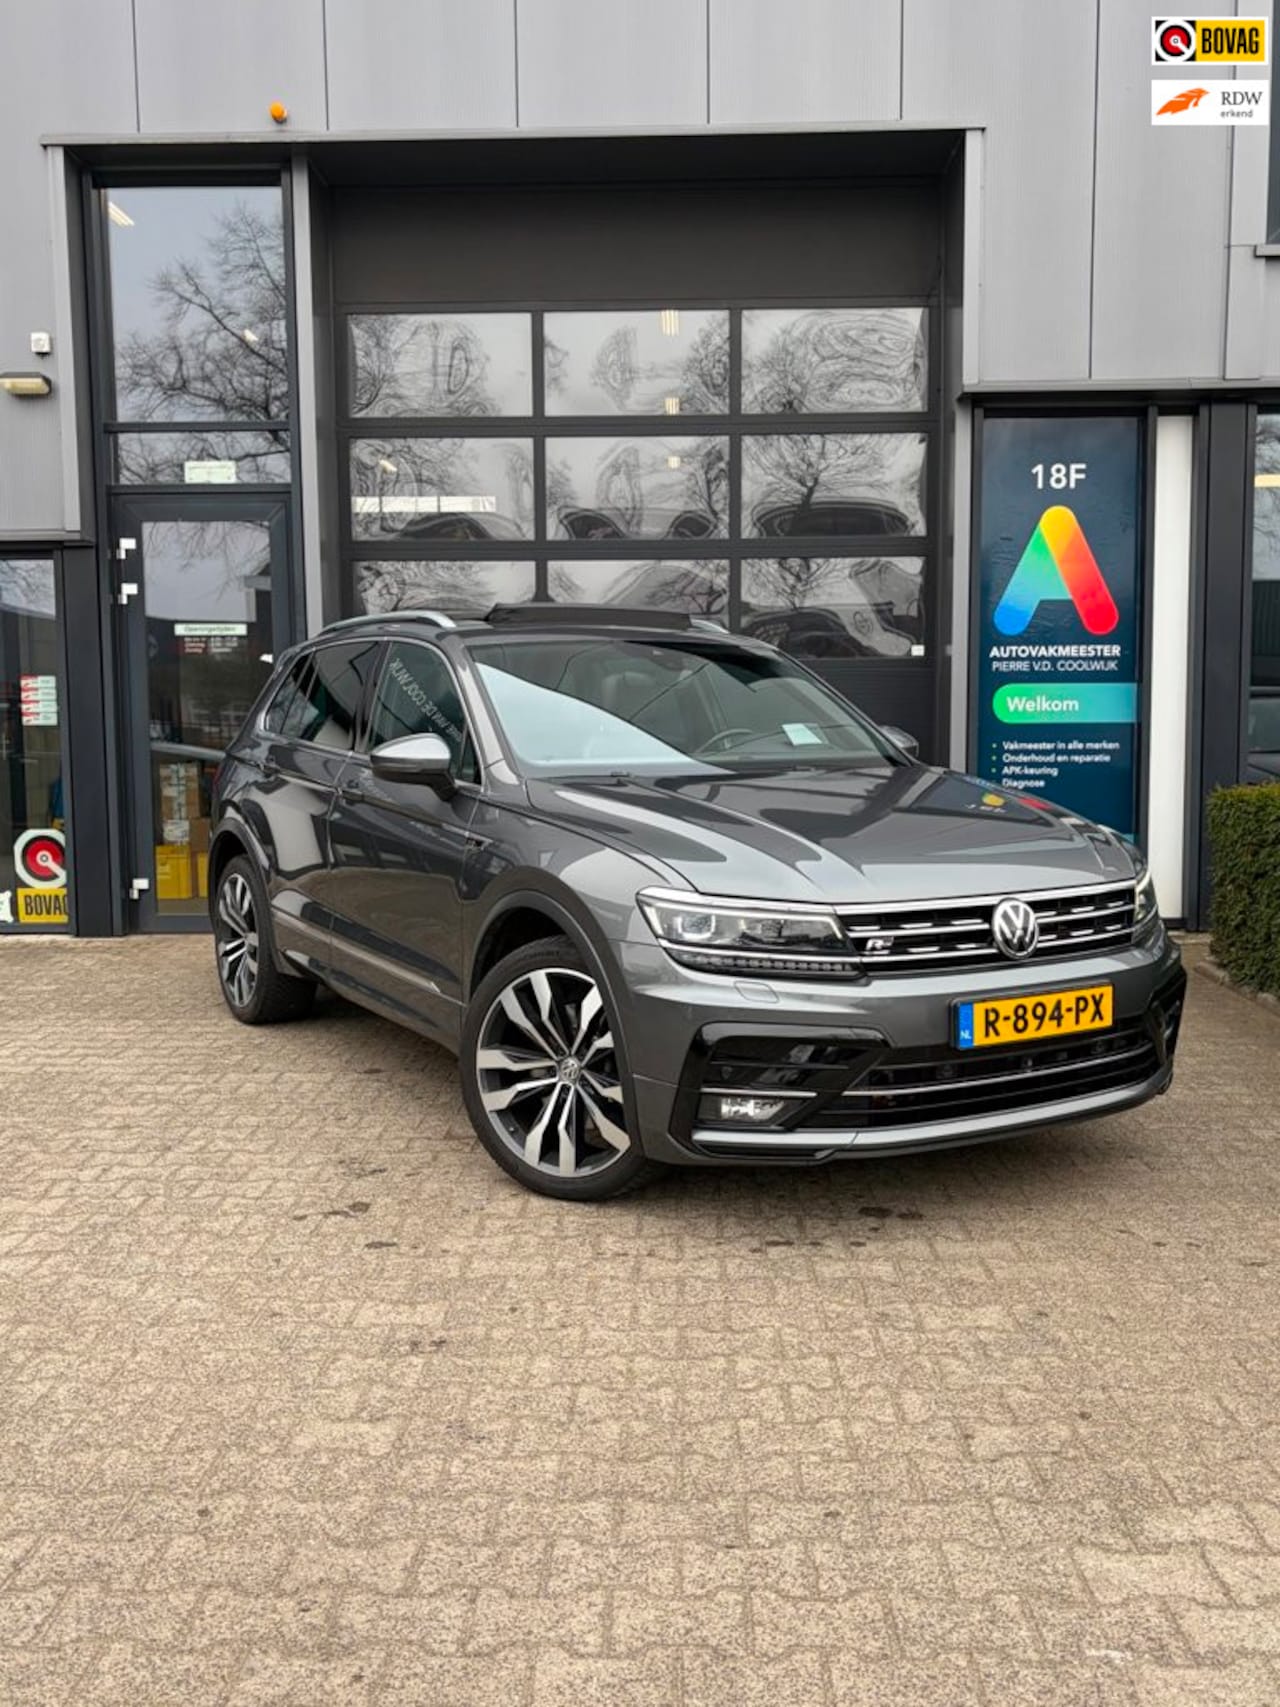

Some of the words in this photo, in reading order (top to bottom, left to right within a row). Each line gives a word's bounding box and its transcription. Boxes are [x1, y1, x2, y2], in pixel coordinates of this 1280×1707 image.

[1031, 463, 1087, 489] 18F
[989, 644, 1122, 659] AUTOVAKMEESTER
[991, 660, 1030, 672] PIERRE
[1032, 660, 1055, 672] V.D.
[1056, 659, 1119, 672] COOLWIJK
[1006, 694, 1080, 712] Welkom
[1002, 740, 1055, 750] Vakmeester
[1057, 741, 1066, 750] in
[1067, 740, 1084, 750] alle
[1085, 740, 1120, 750] merken
[1002, 753, 1056, 763] Onderhoud
[1057, 755, 1069, 763] en
[1070, 754, 1111, 764] reparatie
[1002, 765, 1059, 777] APK-keuring
[1002, 778, 1045, 789] Diagnose
[984, 992, 1105, 1039] R-894-PX
[960, 1030, 972, 1040] NL
